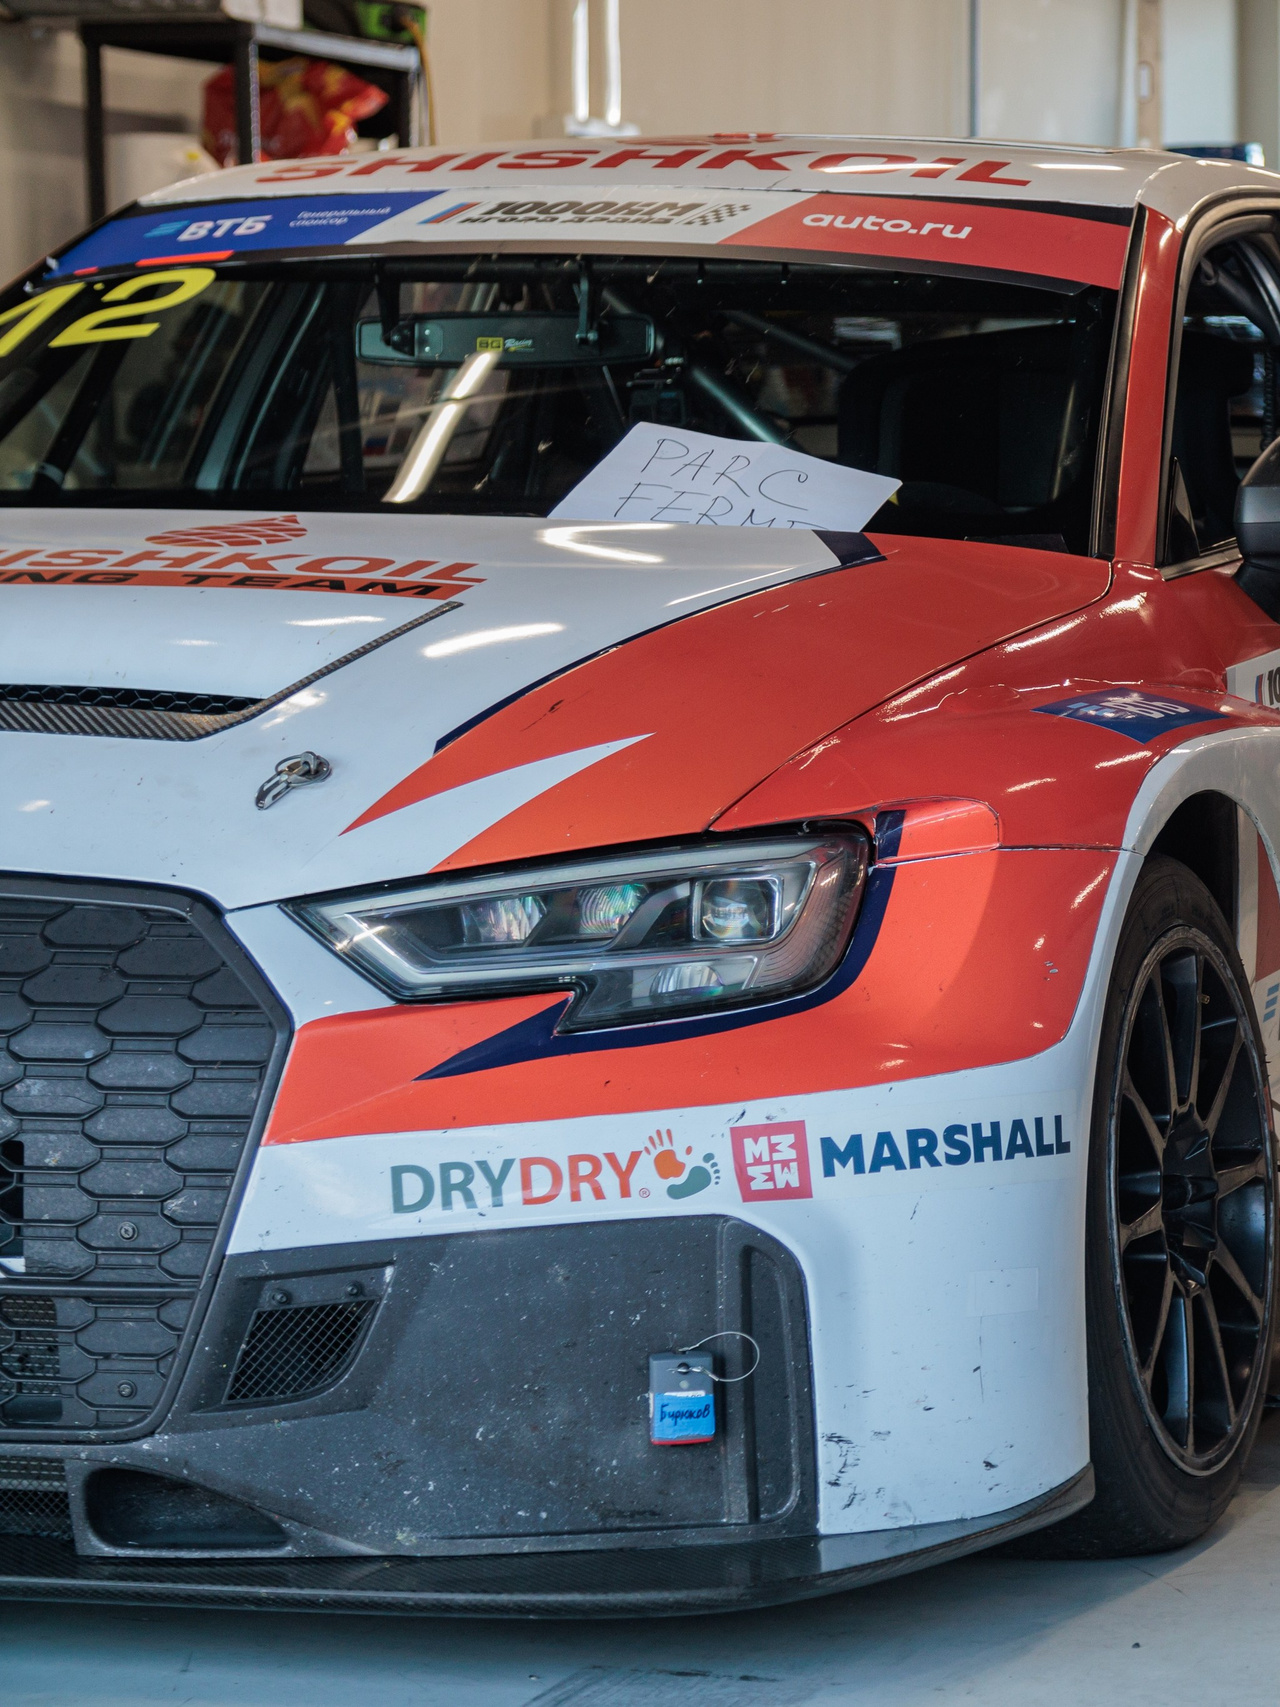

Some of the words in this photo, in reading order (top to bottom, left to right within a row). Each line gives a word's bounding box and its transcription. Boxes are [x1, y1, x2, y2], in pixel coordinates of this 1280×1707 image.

[256, 148, 1032, 187] SHISHKOIL
[177, 214, 273, 242] ВТБ
[802, 203, 973, 240] auto.ru
[0, 268, 217, 358] 12
[641, 438, 809, 511] PARC
[0, 548, 488, 583] ISHKOIL
[0, 571, 139, 584] NG
[182, 573, 441, 596] TEAM
[820, 1115, 1071, 1178] MARSHALL
[660, 1403, 711, 1426] Бирюков
